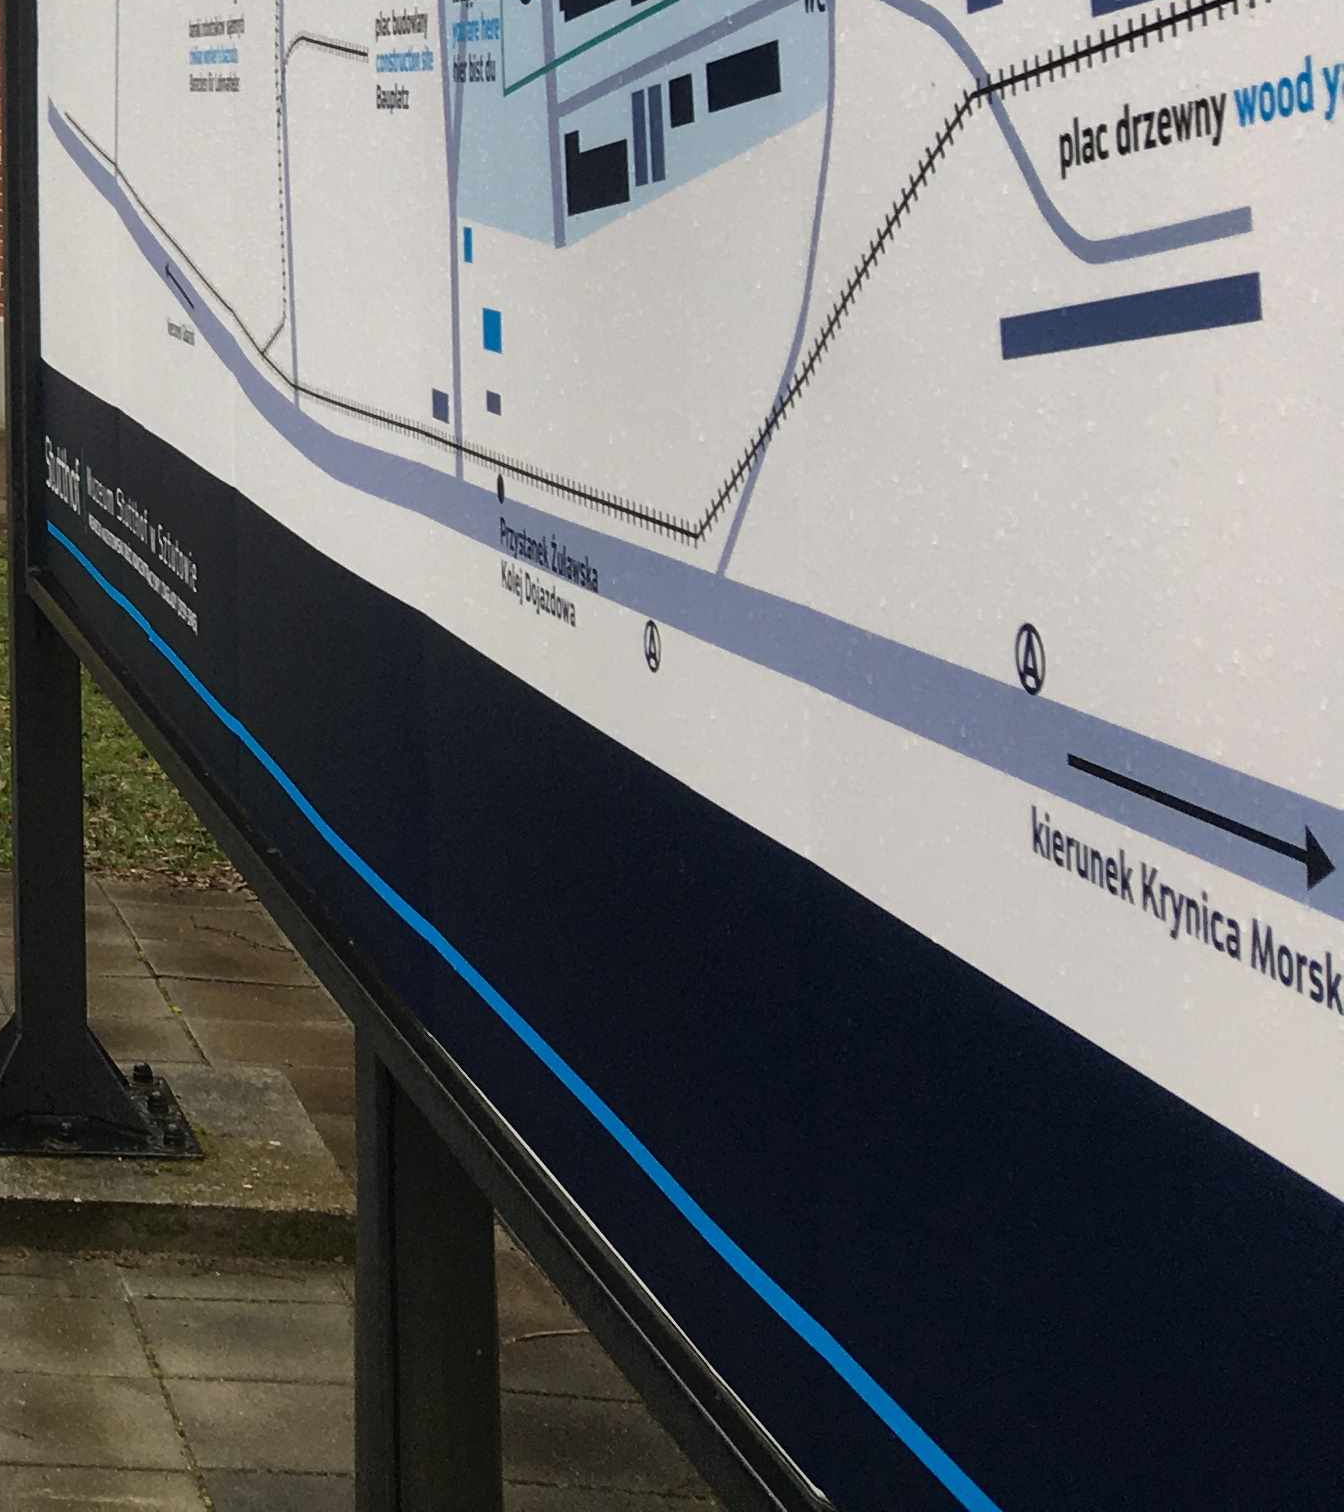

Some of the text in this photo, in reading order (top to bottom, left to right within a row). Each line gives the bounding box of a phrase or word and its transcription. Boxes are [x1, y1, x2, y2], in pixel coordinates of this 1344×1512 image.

[1059, 116, 1109, 180] plac
[1116, 92, 1228, 156] drzewny
[1233, 54, 1314, 127] wood
[500, 516, 549, 569] Przystanek
[501, 559, 576, 628] Kolej Dojazdowa
[1030, 804, 1344, 1016] kierunek Krynica Morsk
